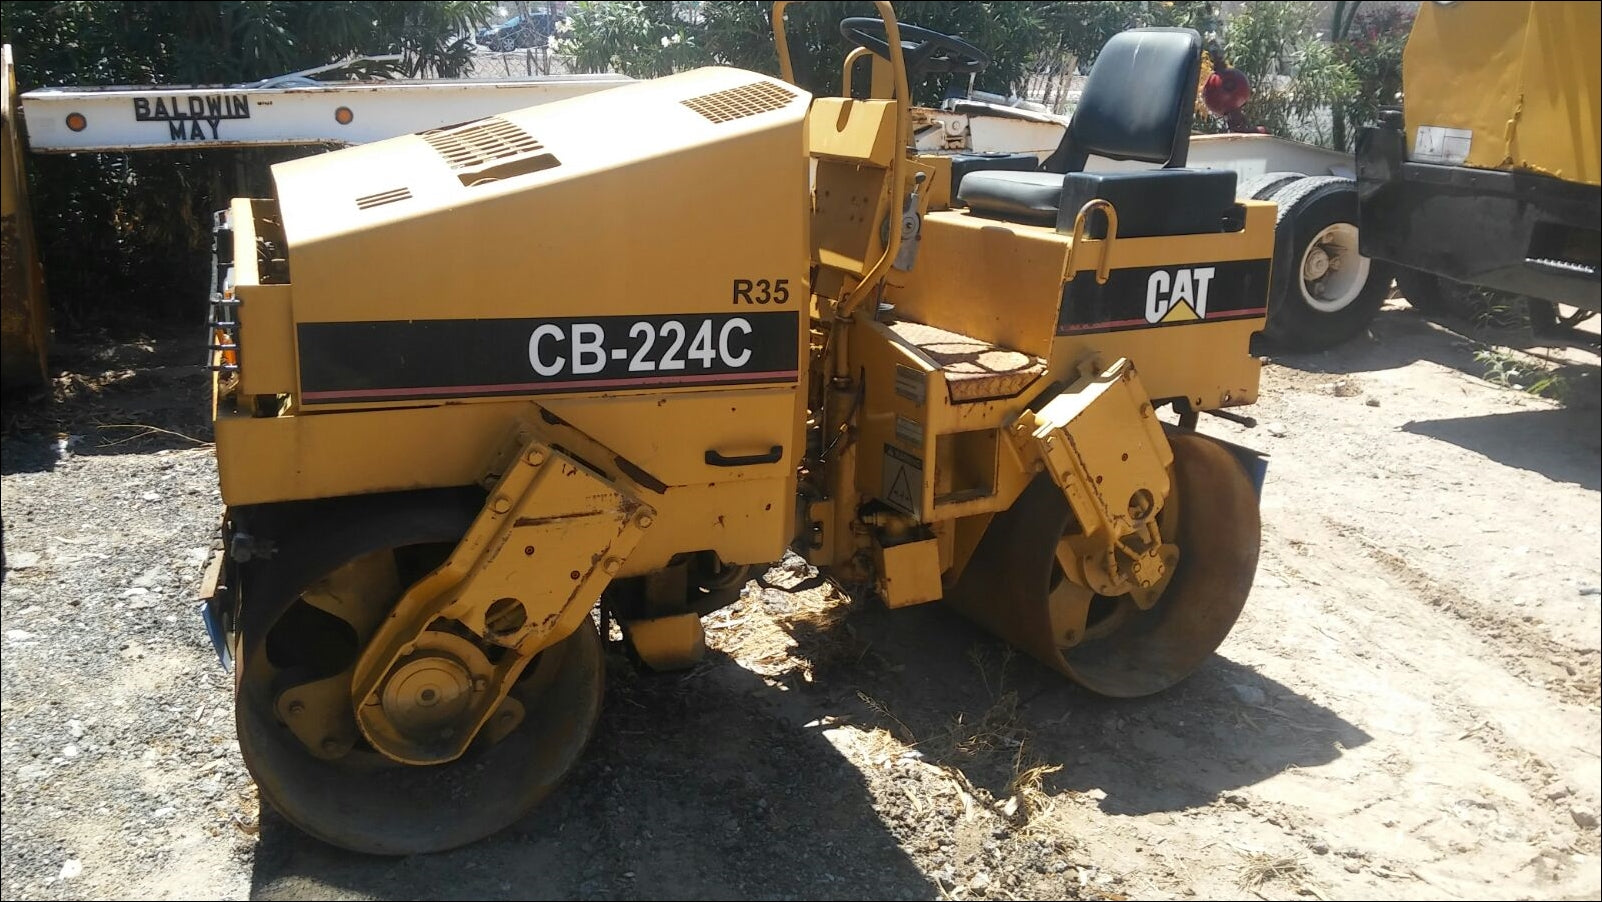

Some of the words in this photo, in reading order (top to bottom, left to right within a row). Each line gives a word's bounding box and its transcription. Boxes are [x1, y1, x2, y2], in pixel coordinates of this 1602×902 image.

[133, 94, 250, 120] BALDWIN
[168, 119, 221, 141] MAY
[732, 279, 790, 305] R35
[1145, 267, 1216, 324] CAT
[528, 317, 753, 377] CB-224C
